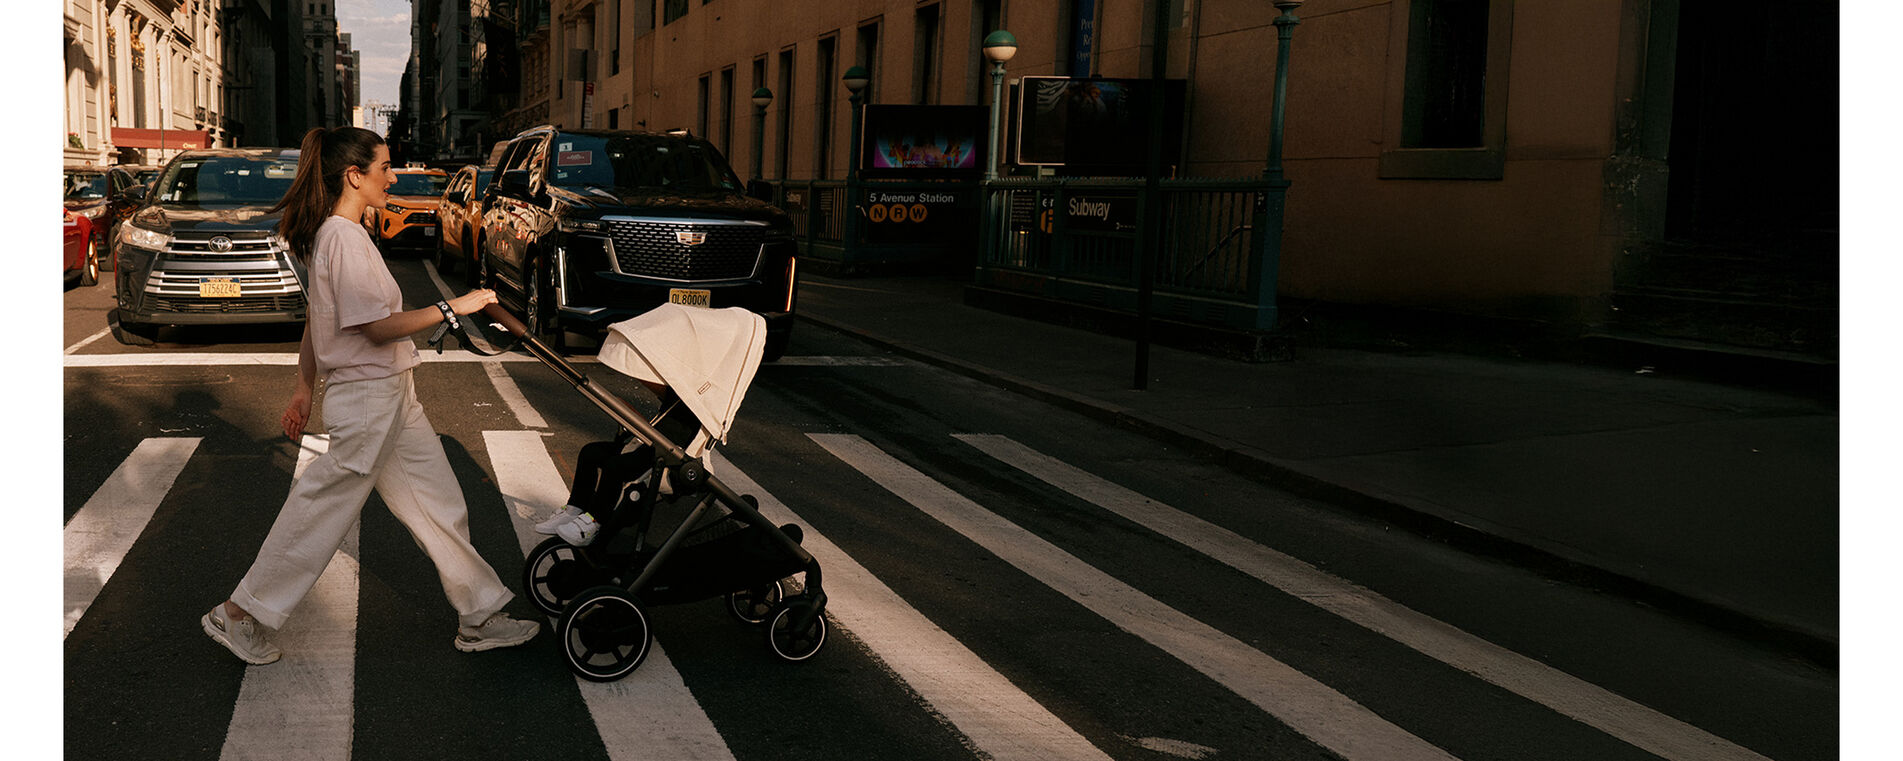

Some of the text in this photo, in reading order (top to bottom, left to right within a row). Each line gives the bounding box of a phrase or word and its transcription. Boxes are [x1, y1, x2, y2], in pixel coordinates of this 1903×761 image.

[869, 192, 955, 203] 5 Avenue Station
[1068, 196, 1112, 222] Subway
